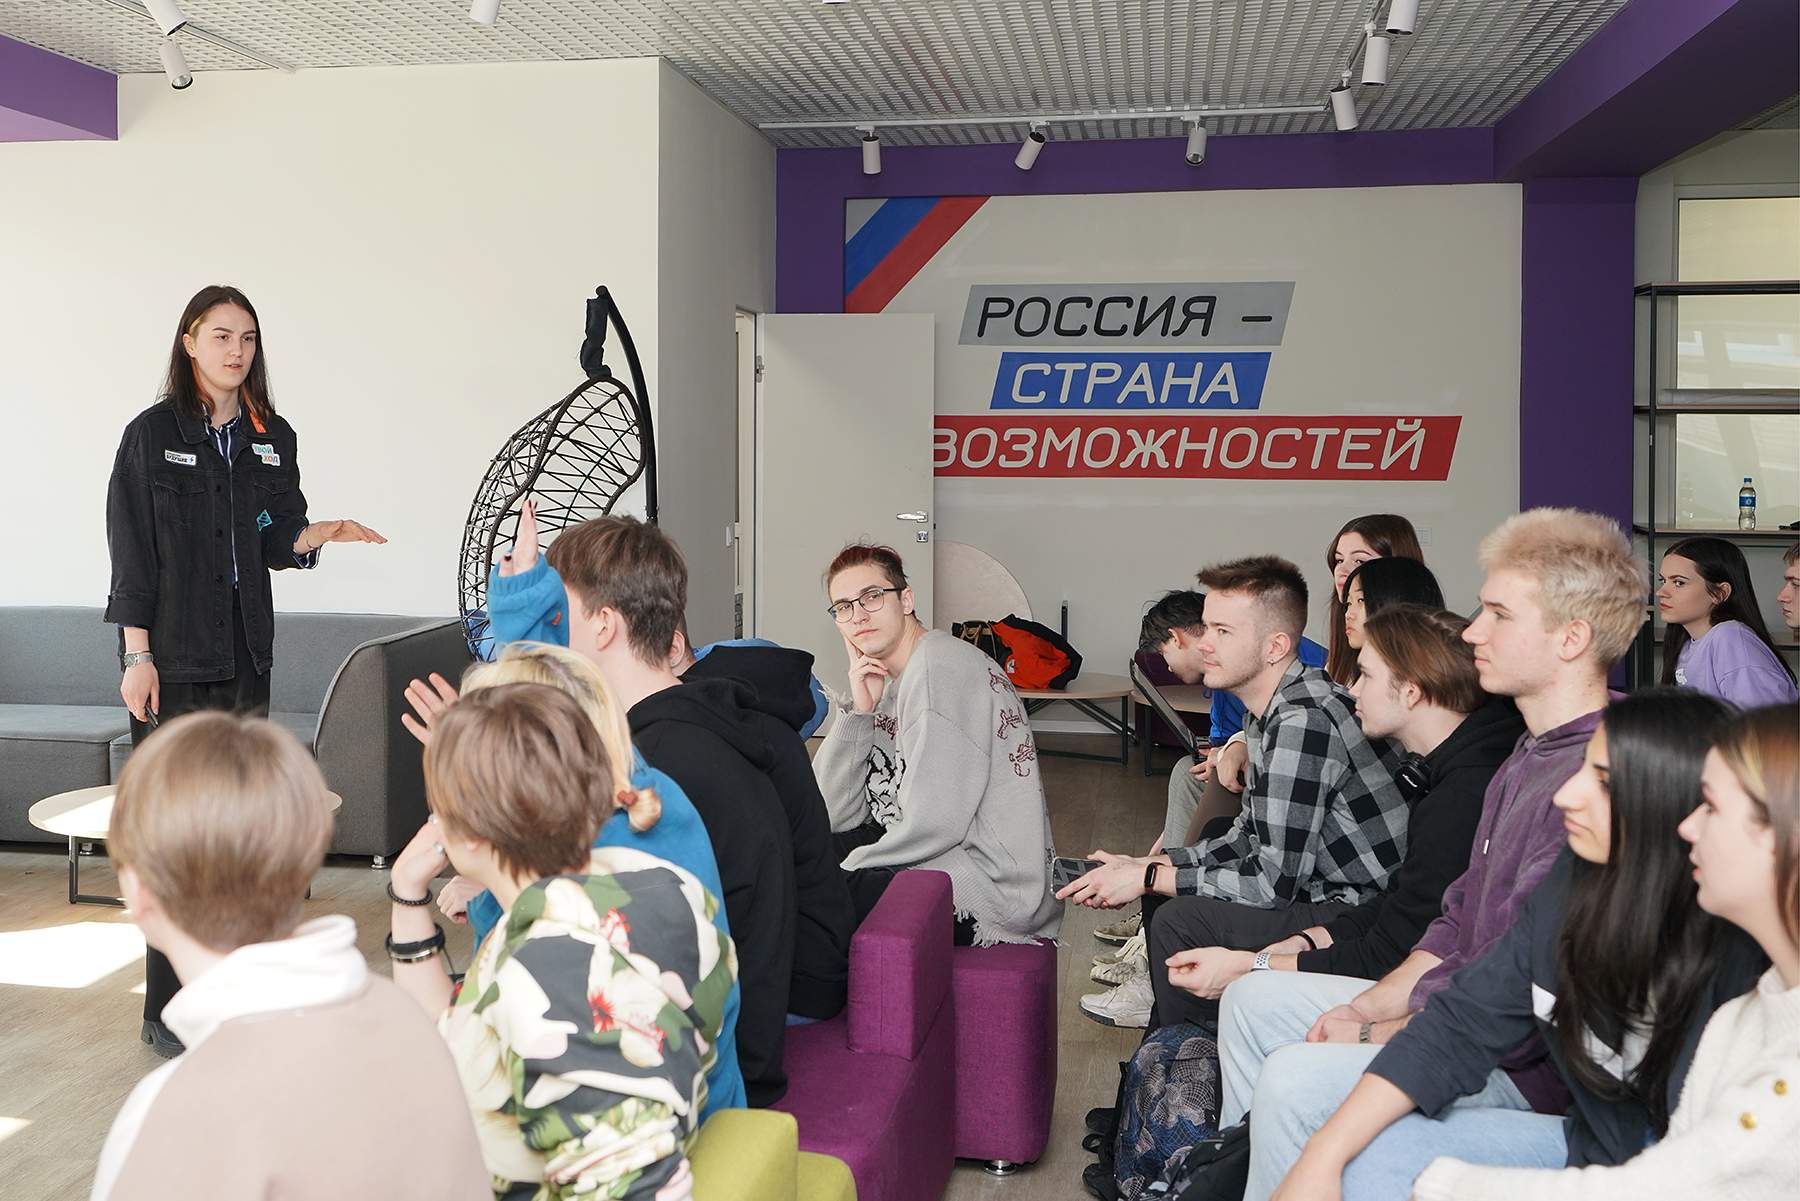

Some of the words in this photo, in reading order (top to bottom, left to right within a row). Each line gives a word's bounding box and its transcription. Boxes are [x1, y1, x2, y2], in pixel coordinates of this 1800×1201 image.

[977, 295, 1217, 338] РОССИЯ
[1011, 361, 1239, 404] СТРАНА
[934, 418, 1426, 471] ВОЗМОЖНОСТЕЙ
